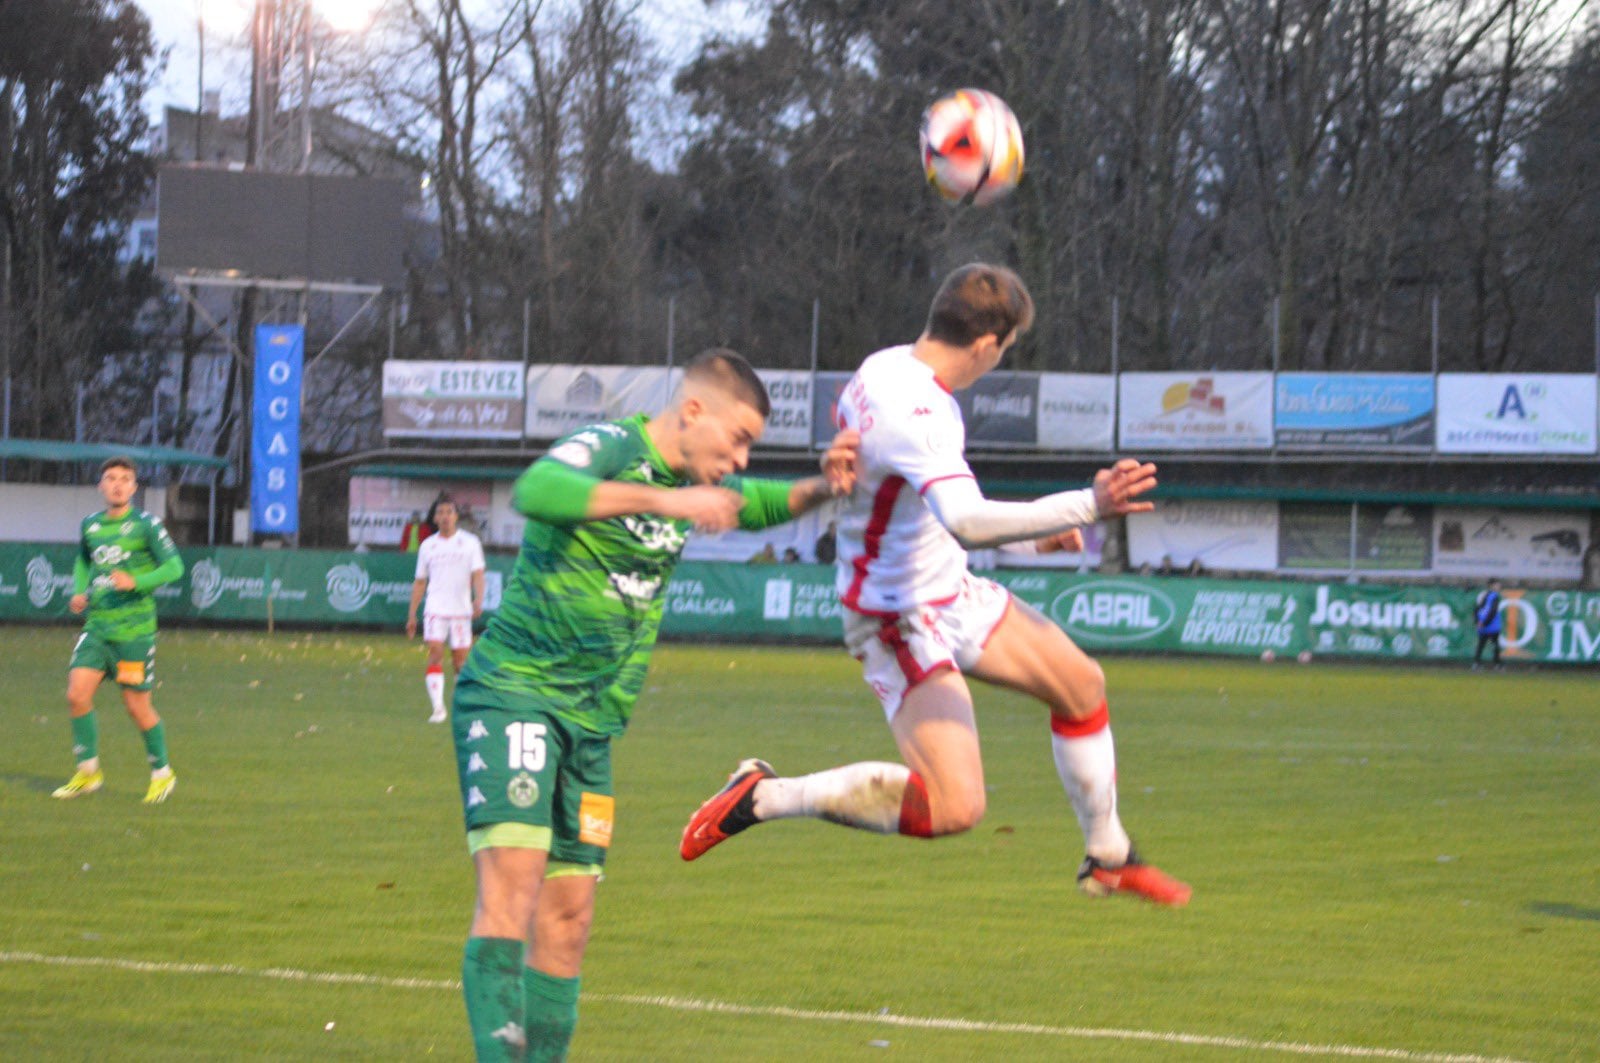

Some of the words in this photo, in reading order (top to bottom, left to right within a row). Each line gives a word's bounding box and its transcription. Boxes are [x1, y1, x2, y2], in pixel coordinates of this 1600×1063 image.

[264, 360, 291, 526] OCASO
[350, 516, 404, 530] MANUE
[672, 599, 736, 615] GALICIA
[818, 602, 843, 619] GA
[1067, 592, 1160, 628] ABRIL
[1180, 621, 1294, 647] DEPORTISTAS
[1545, 619, 1600, 660] IM
[505, 721, 548, 772] 15
